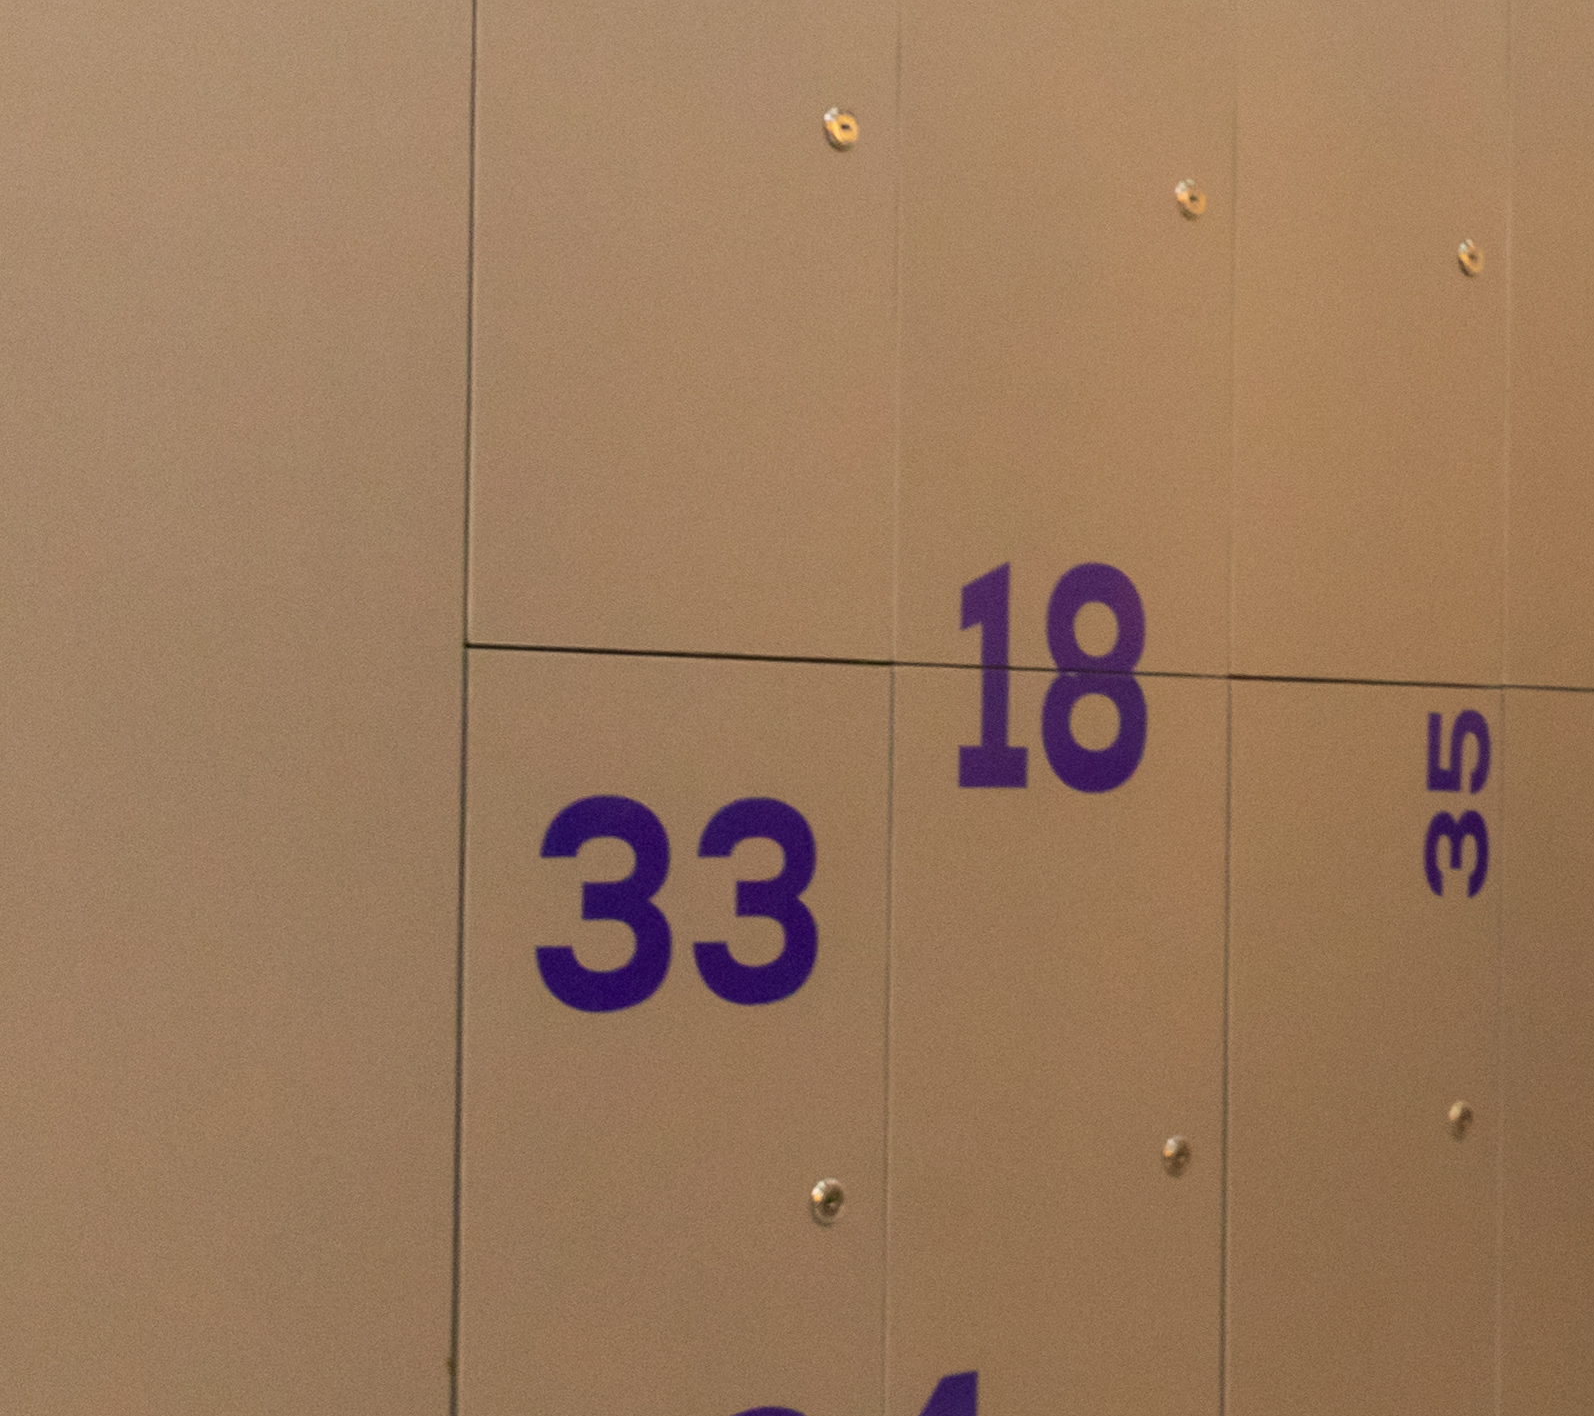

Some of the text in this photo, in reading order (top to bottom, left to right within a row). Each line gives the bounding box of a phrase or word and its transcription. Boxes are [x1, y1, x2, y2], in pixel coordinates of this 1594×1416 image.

[960, 564, 1145, 792] 18
[535, 795, 818, 1013] 33
[1425, 711, 1490, 896] 35
